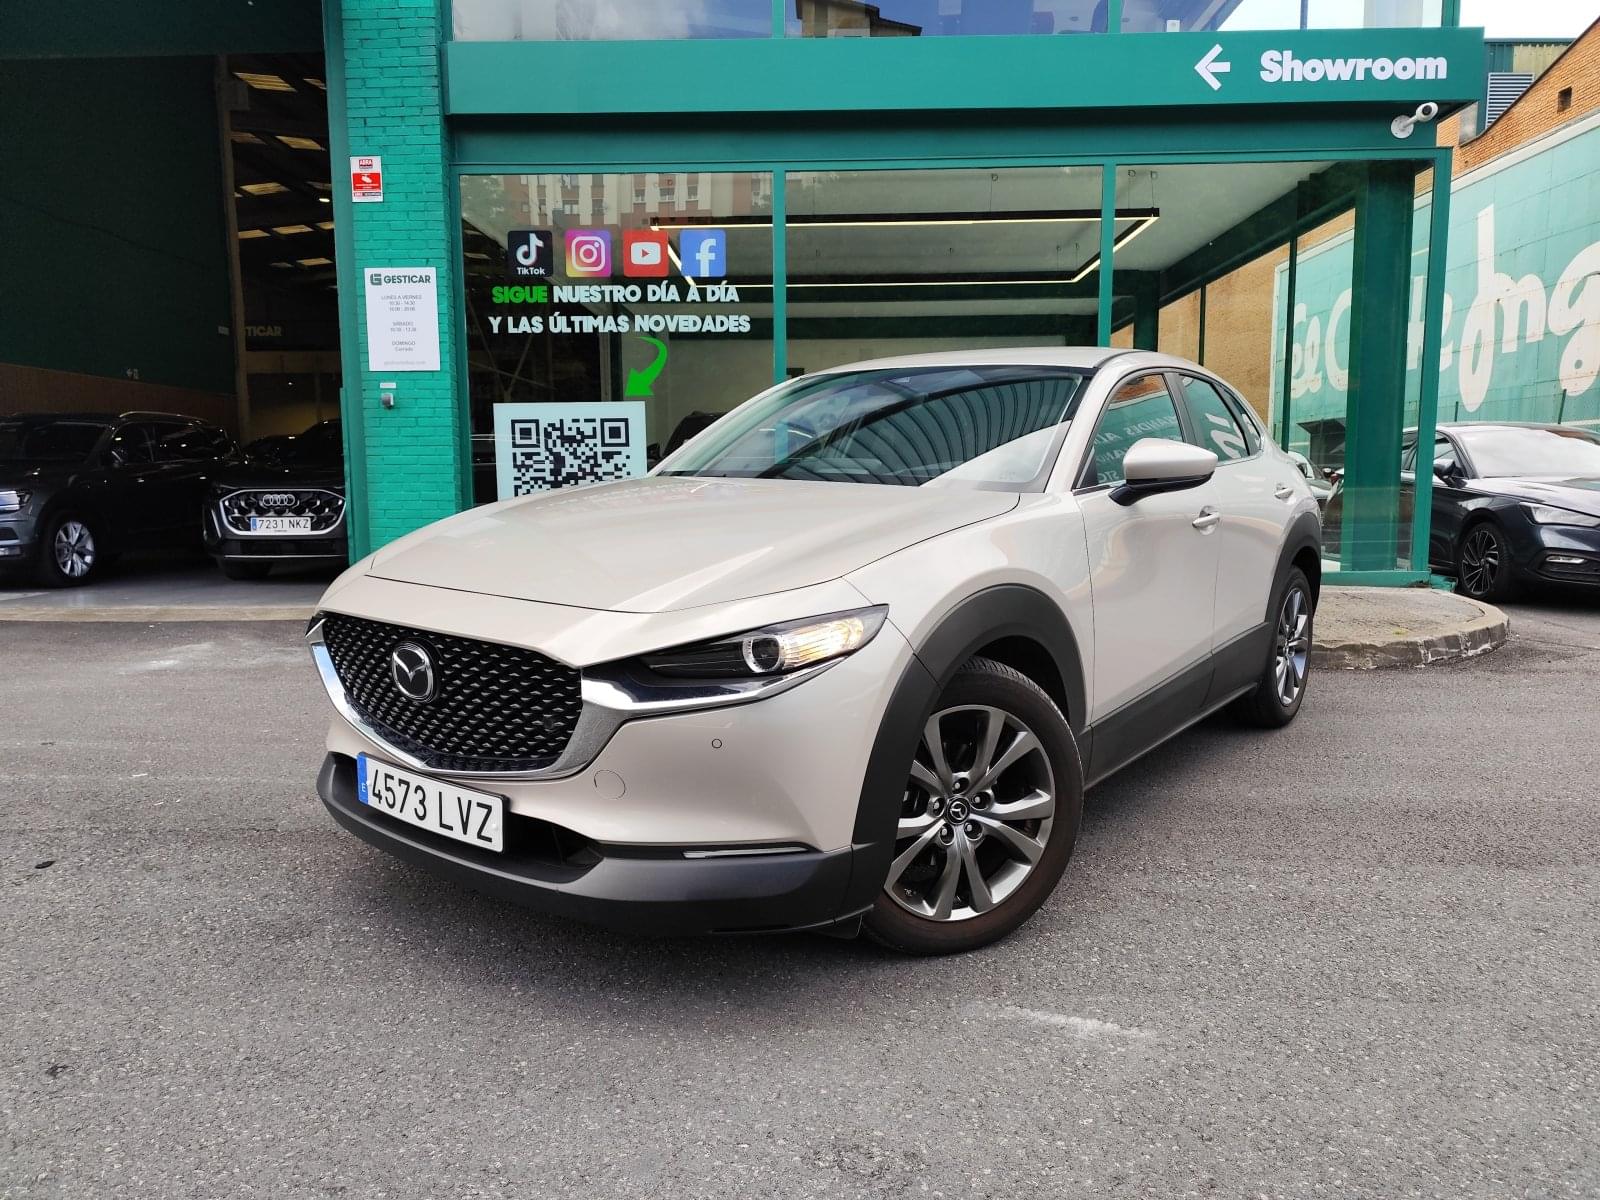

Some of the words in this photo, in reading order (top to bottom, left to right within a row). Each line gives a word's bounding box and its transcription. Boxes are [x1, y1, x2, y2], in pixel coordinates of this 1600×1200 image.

[1259, 49, 1448, 83] Showroom
[383, 275, 431, 284] GESTICAR
[517, 266, 546, 276] TikTok
[491, 285, 548, 304] SIGUE
[553, 284, 642, 304] NUESTRO
[647, 279, 681, 303] DÍA
[686, 284, 701, 303] A
[706, 280, 740, 303] DÍA
[488, 316, 502, 335] Y
[507, 316, 543, 334] LAS
[549, 311, 629, 334] ÚLTIMAS
[634, 314, 751, 333] NOVEDADES
[258, 519, 285, 529] 7231
[288, 518, 309, 528] NKZ
[372, 769, 427, 821] 4573
[439, 791, 493, 843] LVZ
